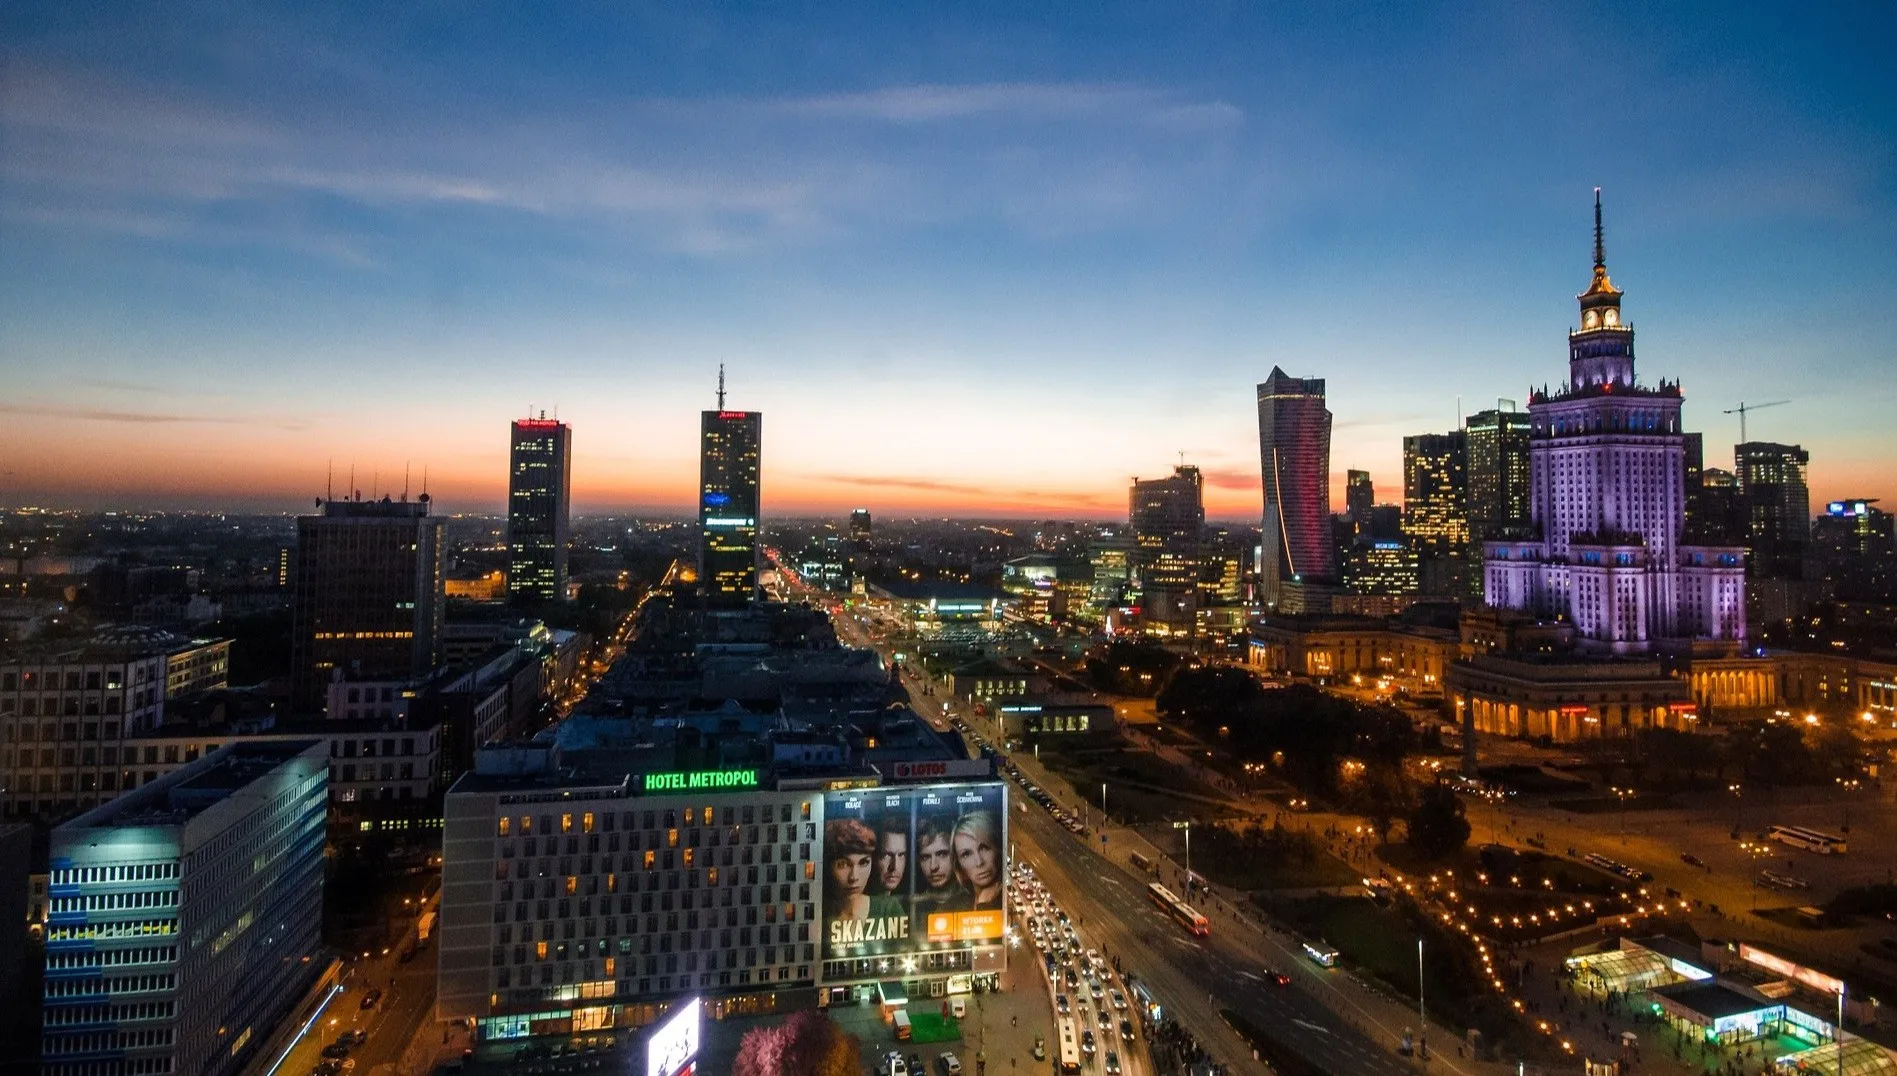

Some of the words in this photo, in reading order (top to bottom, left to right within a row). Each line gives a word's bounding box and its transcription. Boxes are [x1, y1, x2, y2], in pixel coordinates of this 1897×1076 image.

[911, 763, 947, 776] LOTOS
[645, 773, 687, 790] HOTEL
[689, 770, 758, 788] METROPOL
[830, 915, 909, 943] SKAZANE
